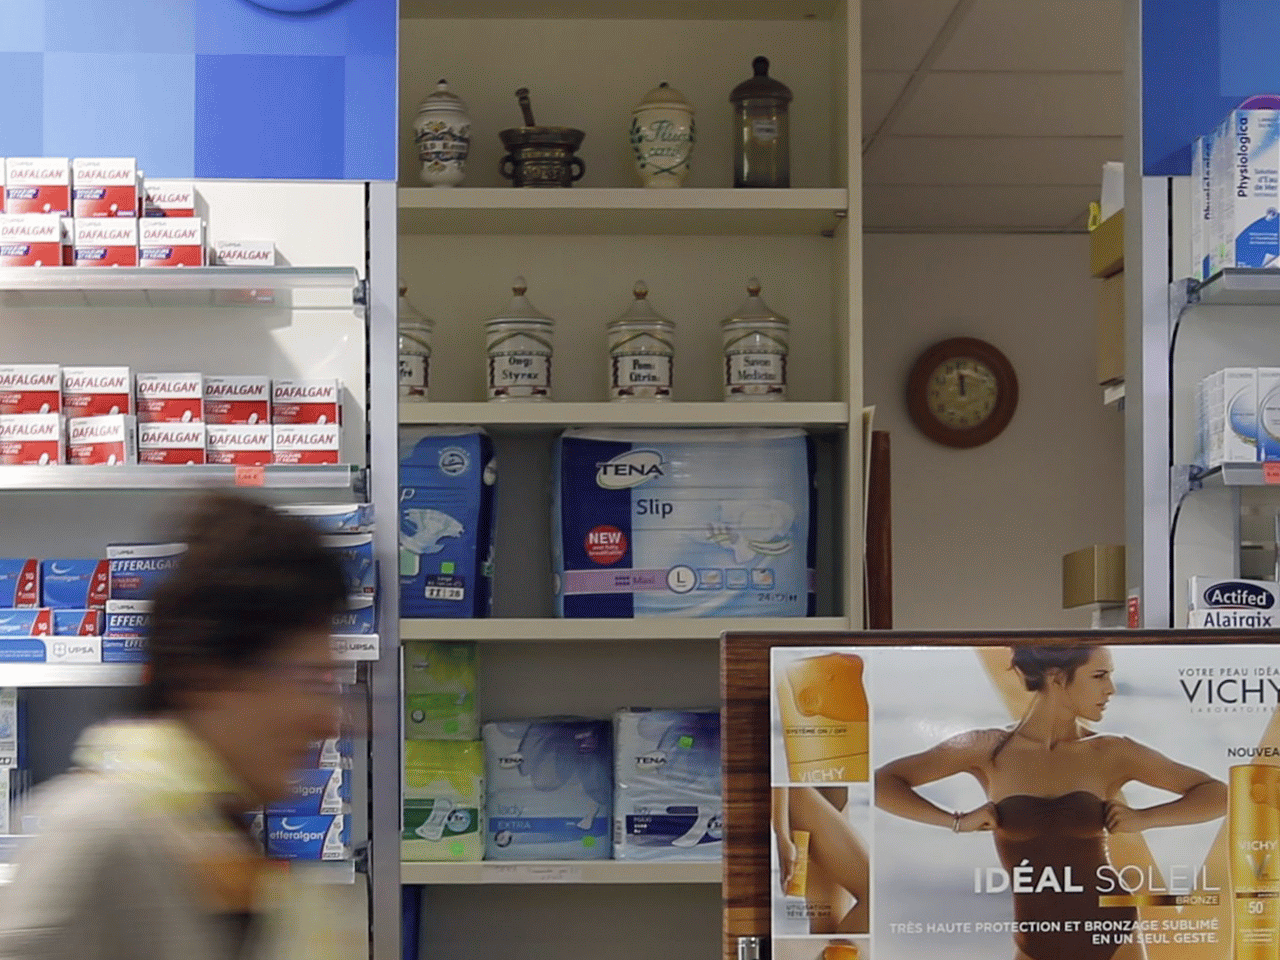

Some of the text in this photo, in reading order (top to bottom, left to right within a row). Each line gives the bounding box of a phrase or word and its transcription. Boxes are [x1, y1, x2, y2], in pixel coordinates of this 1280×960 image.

[1237, 117, 1248, 198] Physiologica
[219, 249, 272, 262] DAFALGAN
[598, 462, 663, 476] TENA
[636, 499, 672, 519] Slip
[589, 531, 621, 544] NEW
[1204, 611, 1273, 628] Alairgix
[68, 645, 94, 656] UPSA
[1178, 668, 1215, 677] VOTRE
[1220, 668, 1249, 677] PEAU
[974, 860, 1219, 894] IDÉAL SOLEIL
[1176, 896, 1219, 905] BRONZE
[890, 917, 1218, 933] TRÈS HAUTE PROTECTION ET BRONZAGE SUBLIMÉ
[1092, 932, 1218, 944] EN UN SEUL GESTE.
